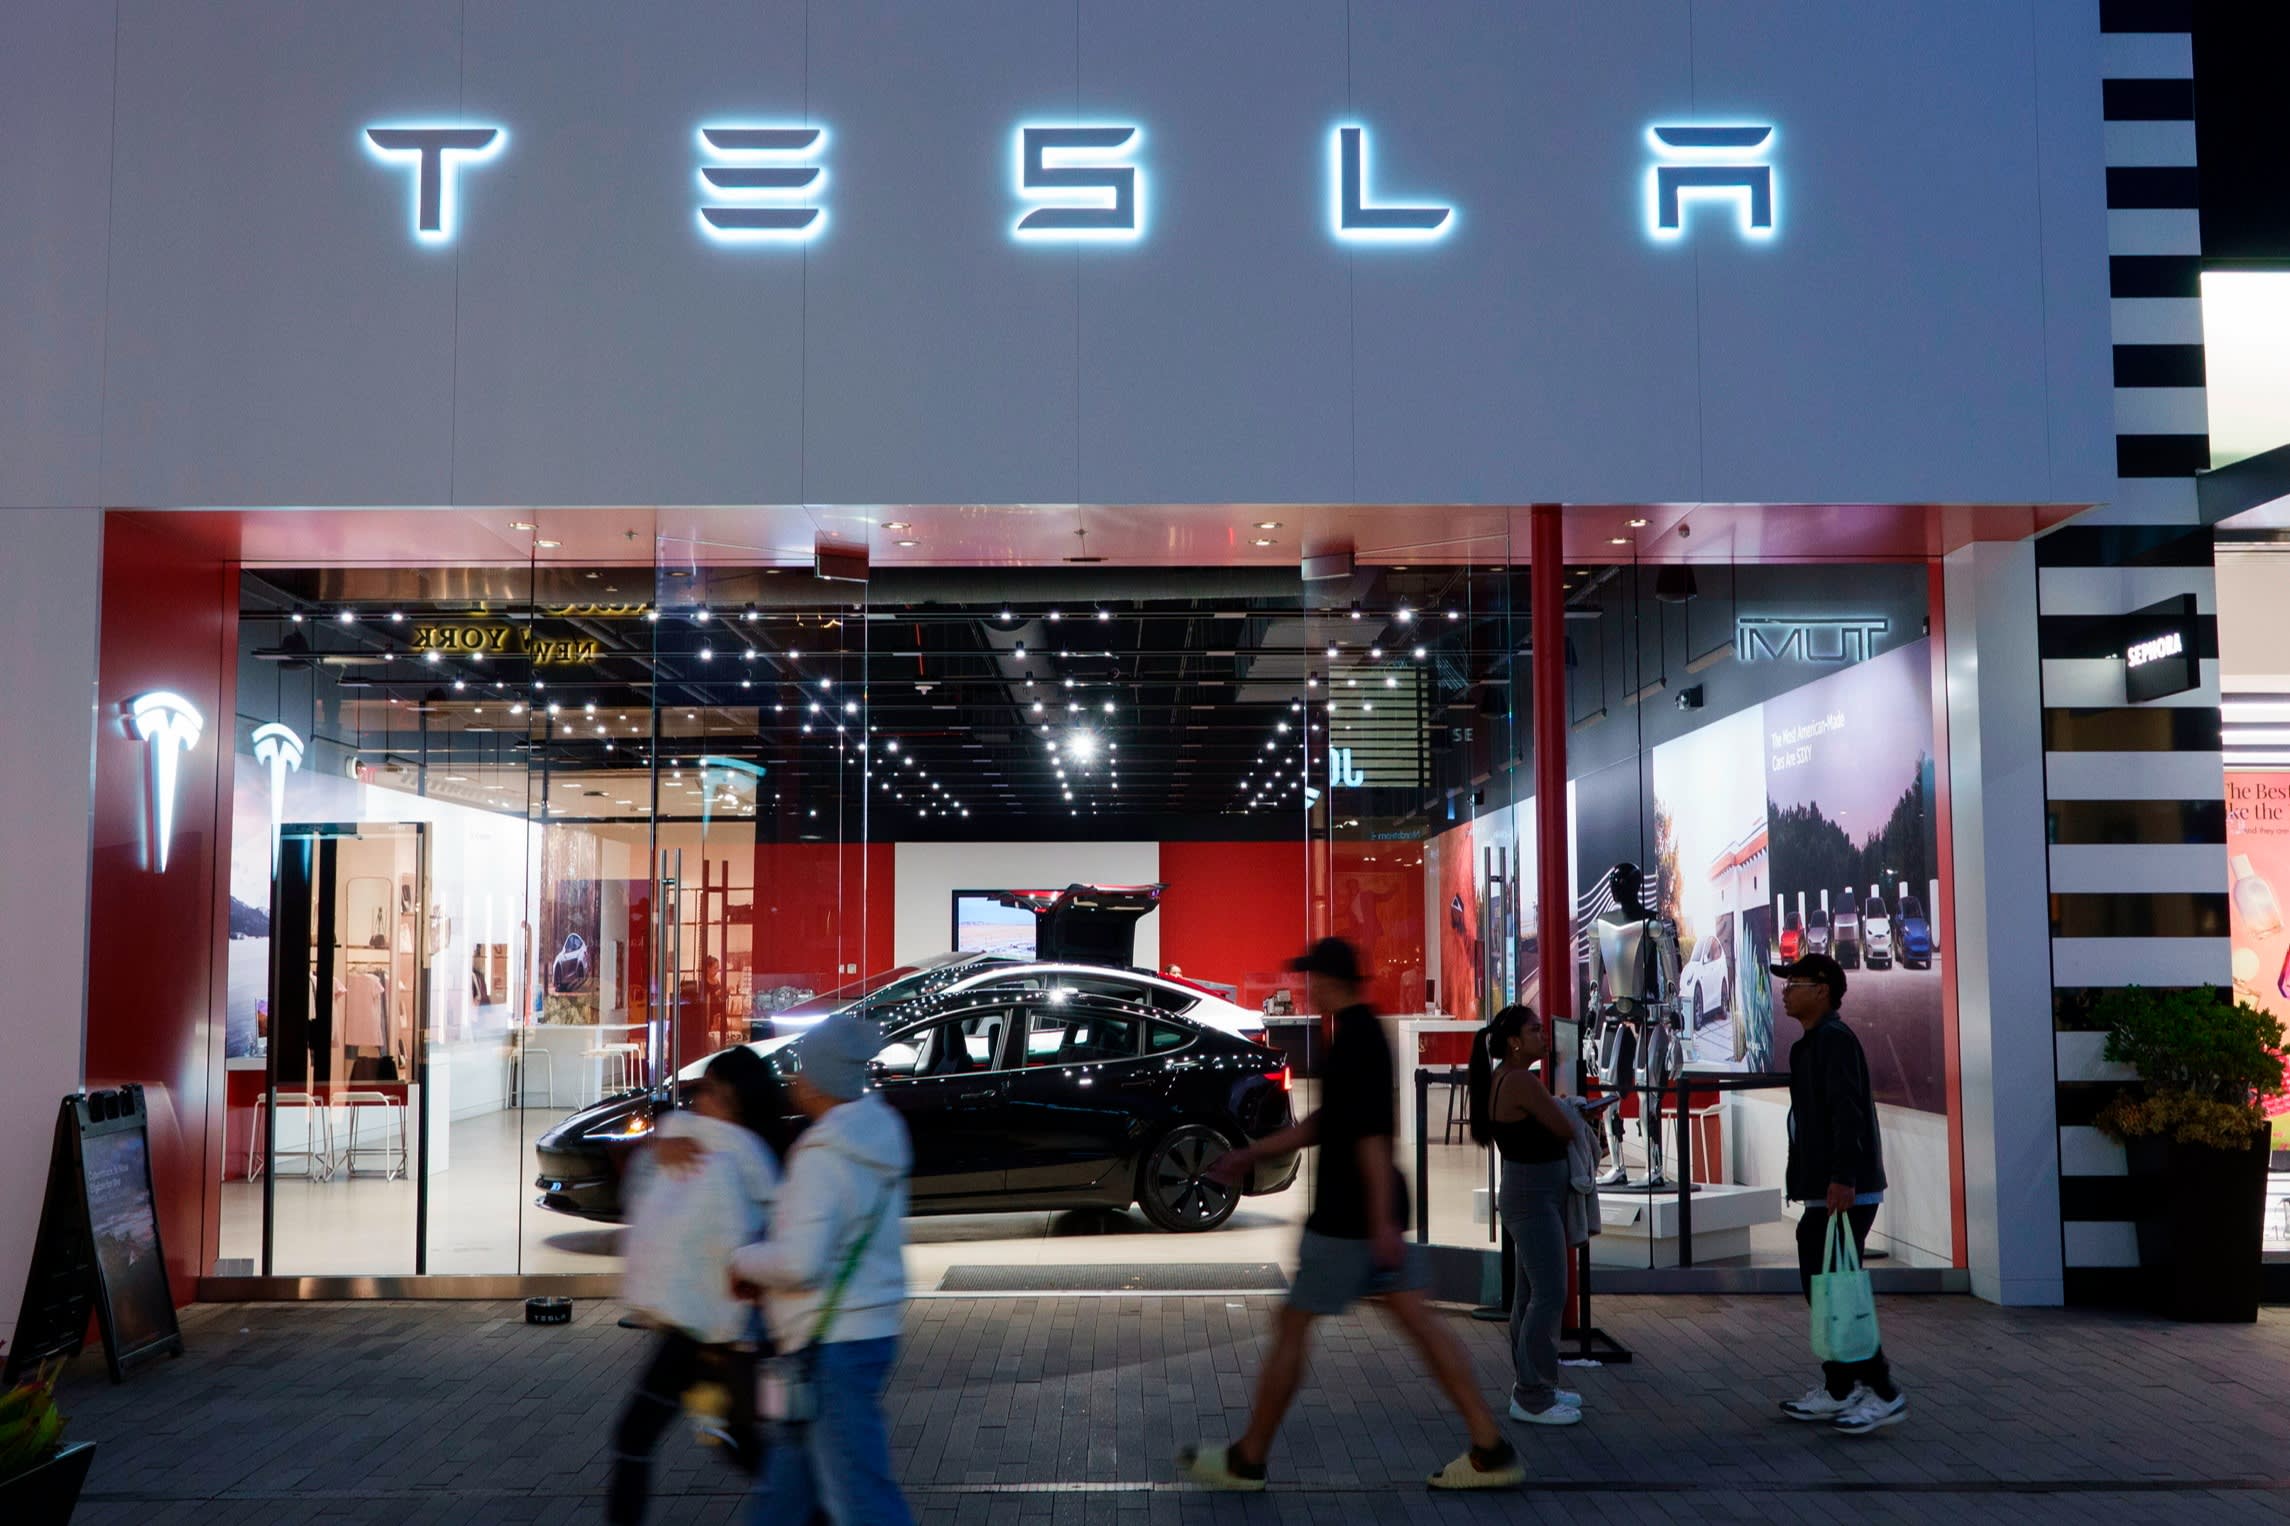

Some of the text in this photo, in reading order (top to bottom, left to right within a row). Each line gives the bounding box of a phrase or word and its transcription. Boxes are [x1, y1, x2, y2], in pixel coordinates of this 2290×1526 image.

[365, 126, 1774, 232] TESLA
[2127, 632, 2183, 668] SEPHORA
[2255, 802, 2282, 820] the
